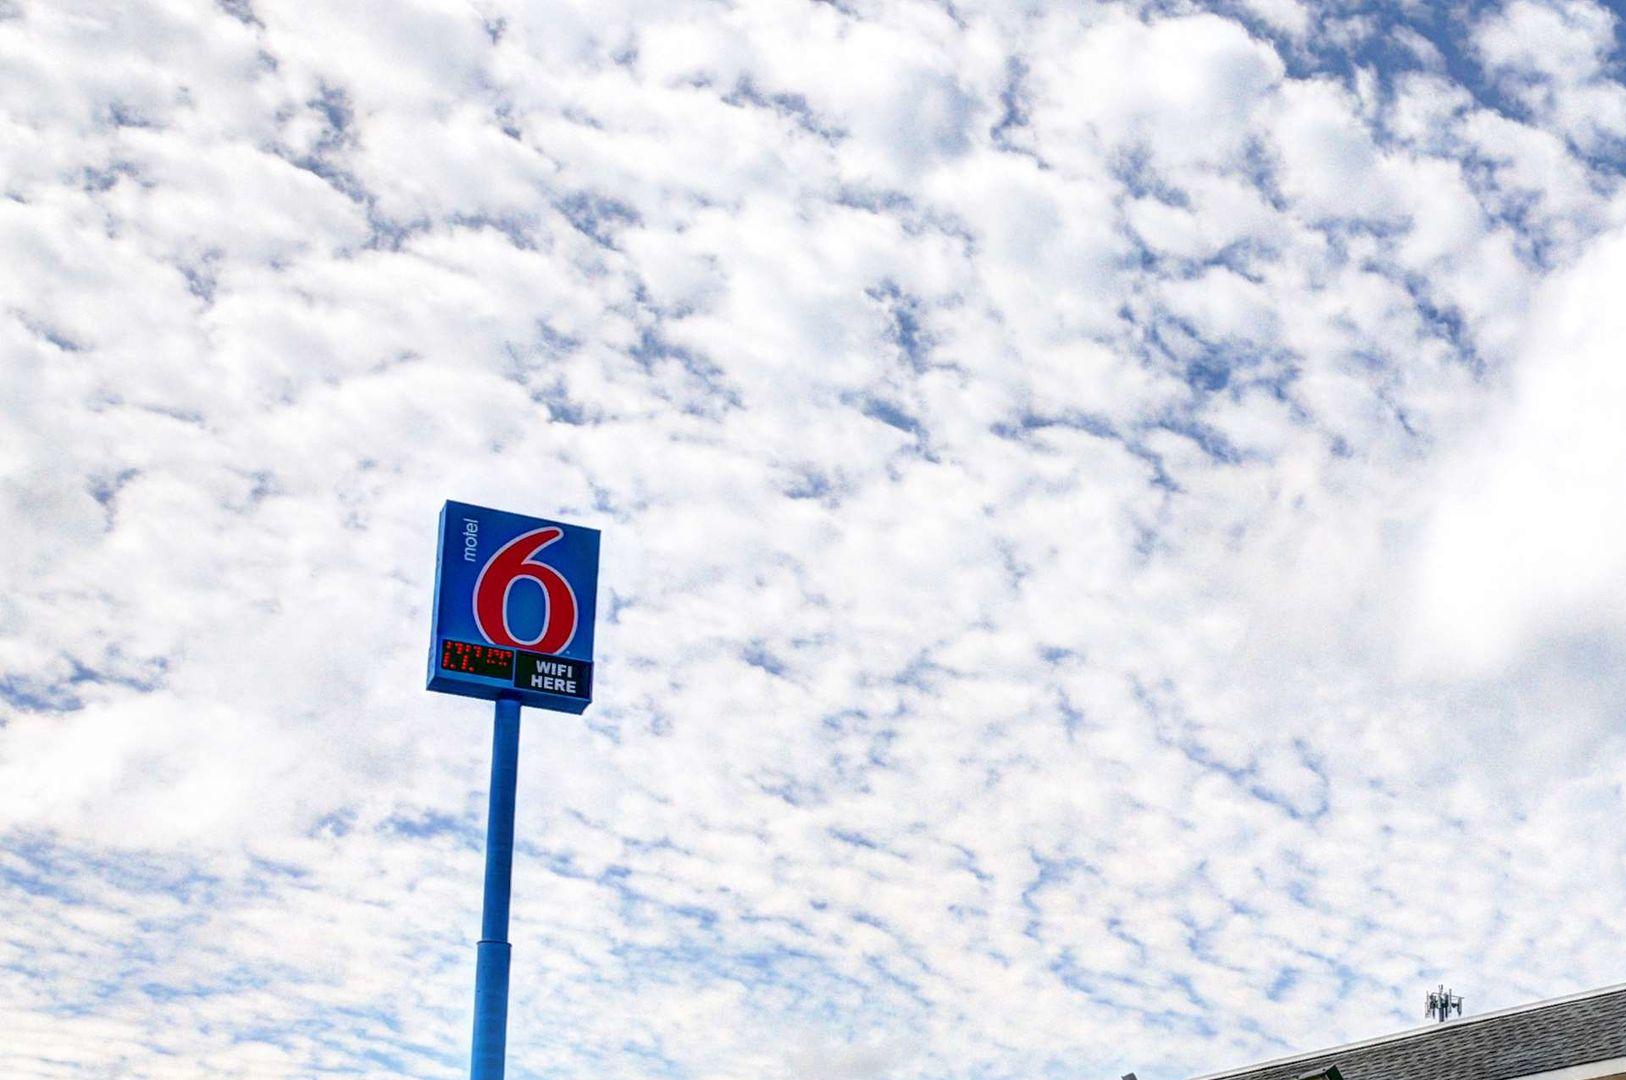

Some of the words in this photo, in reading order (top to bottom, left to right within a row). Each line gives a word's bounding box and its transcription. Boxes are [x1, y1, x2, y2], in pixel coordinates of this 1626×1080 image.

[463, 517, 479, 563] motel
[472, 525, 579, 655] 6
[530, 674, 577, 694] HERE
[535, 660, 573, 679] WIFI
